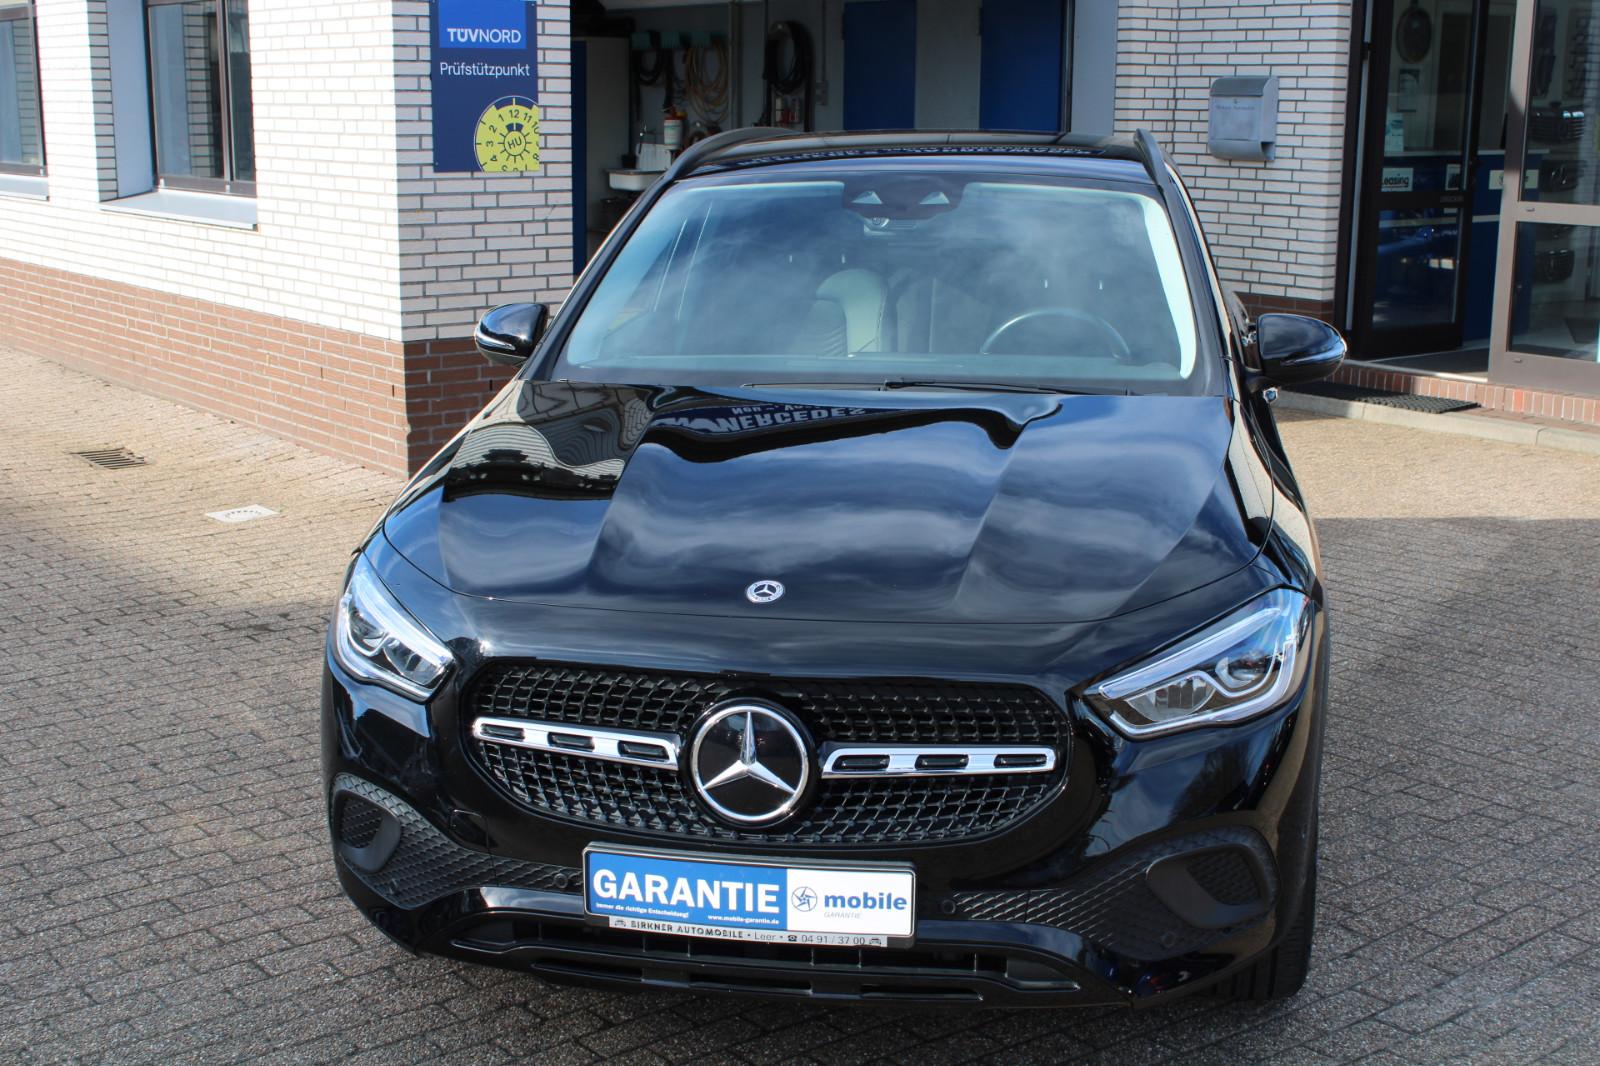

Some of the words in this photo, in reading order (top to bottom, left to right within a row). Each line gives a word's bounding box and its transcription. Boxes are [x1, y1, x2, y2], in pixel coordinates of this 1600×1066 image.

[440, 62, 530, 79] Prüfstützpunkt
[498, 113, 505, 121] 1
[509, 109, 520, 119] 12
[523, 112, 532, 123] 11
[488, 124, 498, 133] 2
[507, 136, 522, 149] HU
[593, 868, 780, 914] GARANTIE
[824, 891, 907, 910] mobile
[708, 914, 780, 925] www.mobile-garantie.de
[677, 924, 743, 938] AUTOMOBILE
[801, 934, 813, 943] 04
[816, 935, 827, 944] 91
[837, 936, 850, 945] 37
[852, 936, 866, 945] 00
